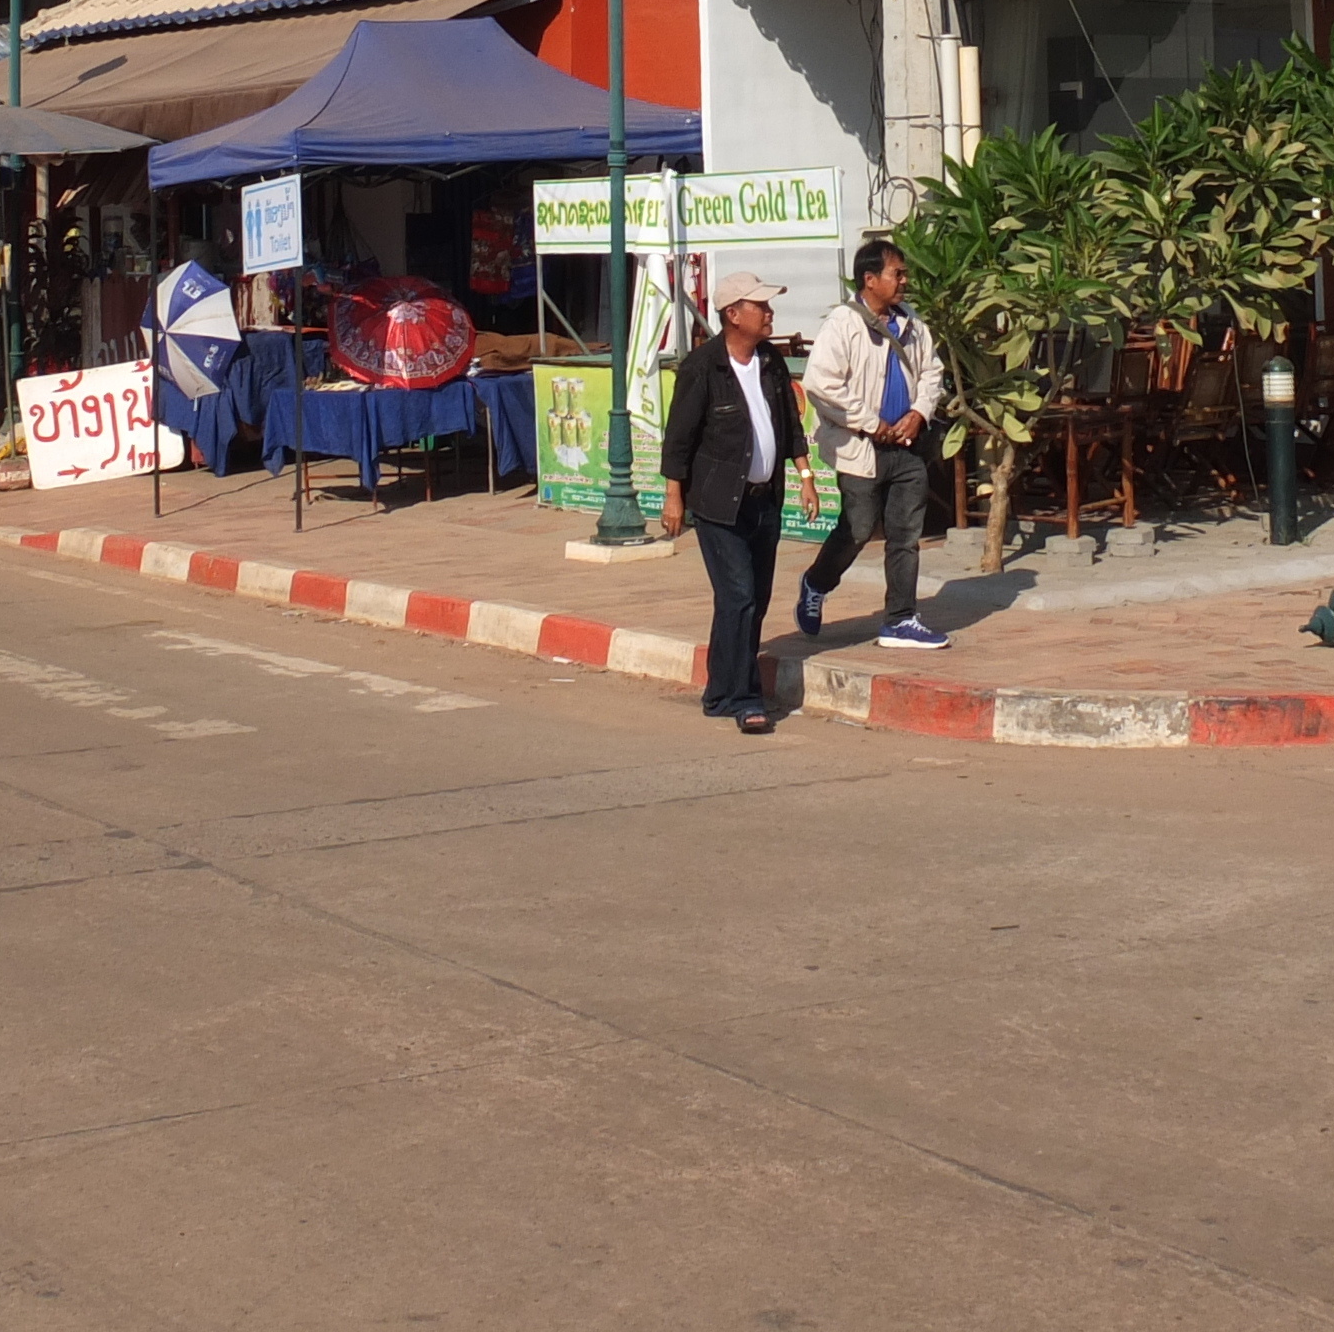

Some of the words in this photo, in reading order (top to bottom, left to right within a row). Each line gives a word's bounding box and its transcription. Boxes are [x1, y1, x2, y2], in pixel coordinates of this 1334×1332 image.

[677, 186, 735, 226] Green
[739, 181, 787, 224] Gold
[790, 179, 829, 221] Tea
